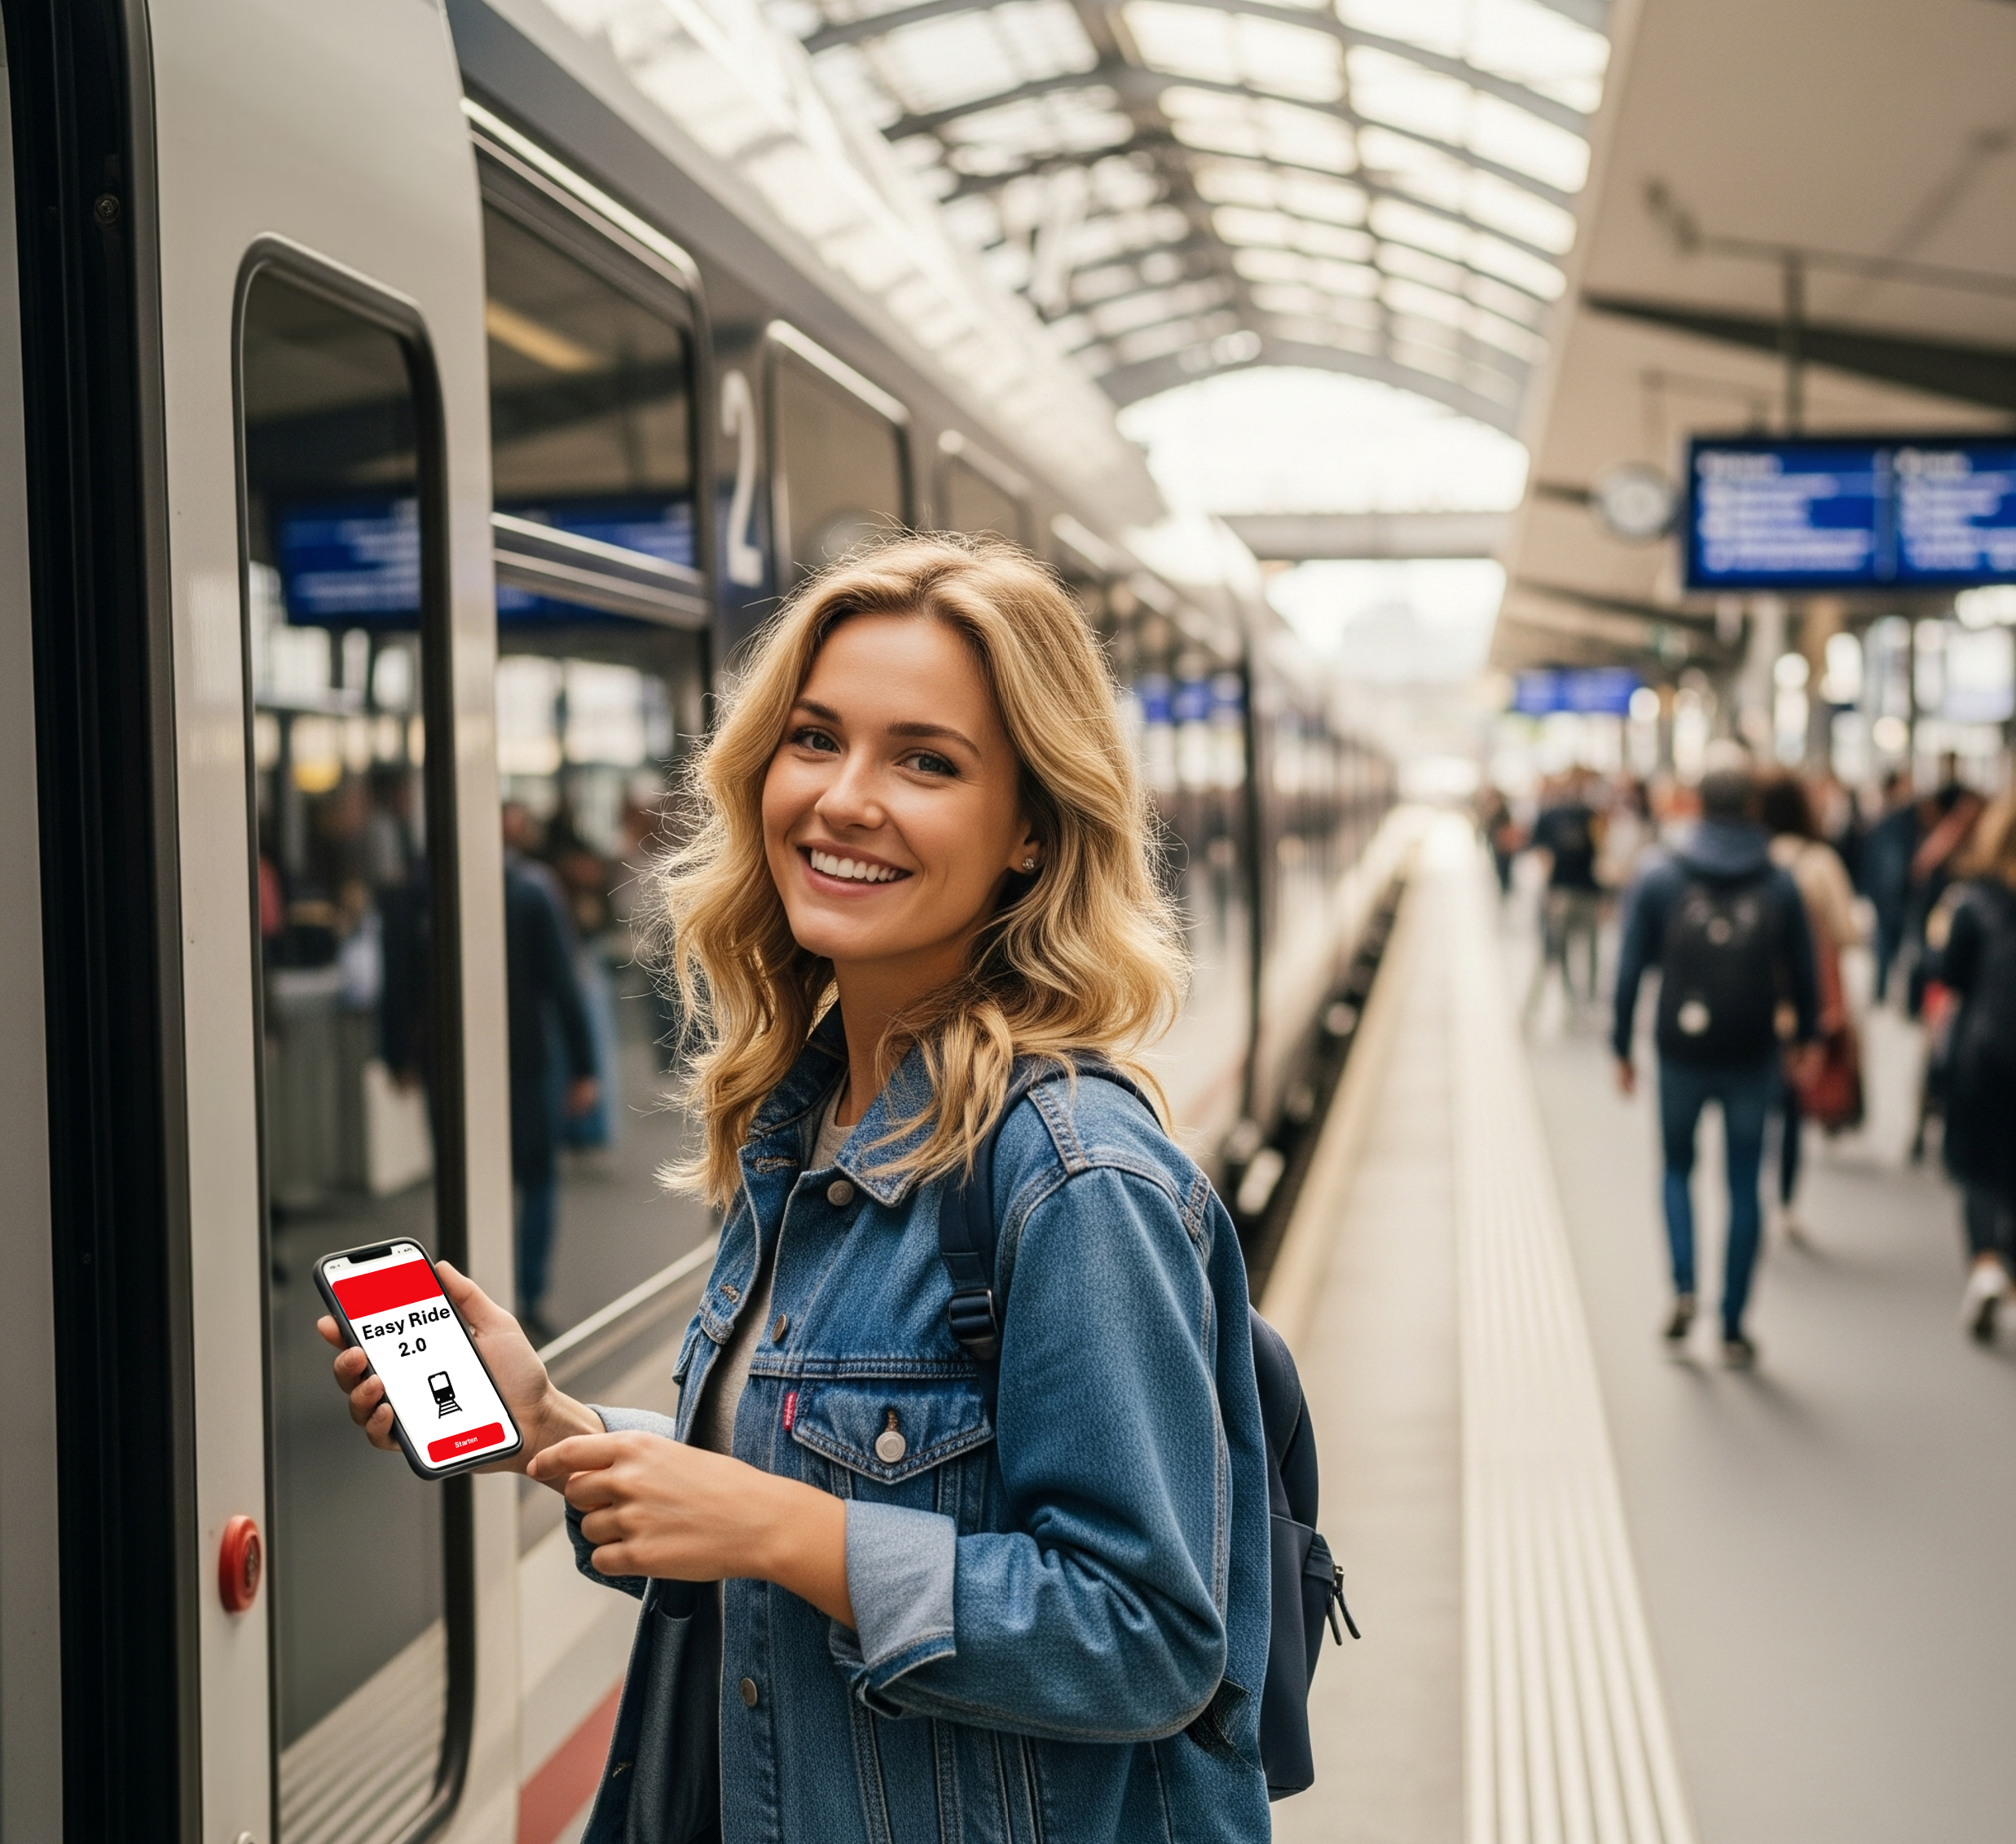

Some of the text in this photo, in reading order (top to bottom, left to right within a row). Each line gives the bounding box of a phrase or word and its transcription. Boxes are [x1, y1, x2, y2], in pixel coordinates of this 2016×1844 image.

[362, 1307, 451, 1340] Easy Ride
[398, 1337, 427, 1358] 2.0
[454, 1437, 478, 1448] Starten
